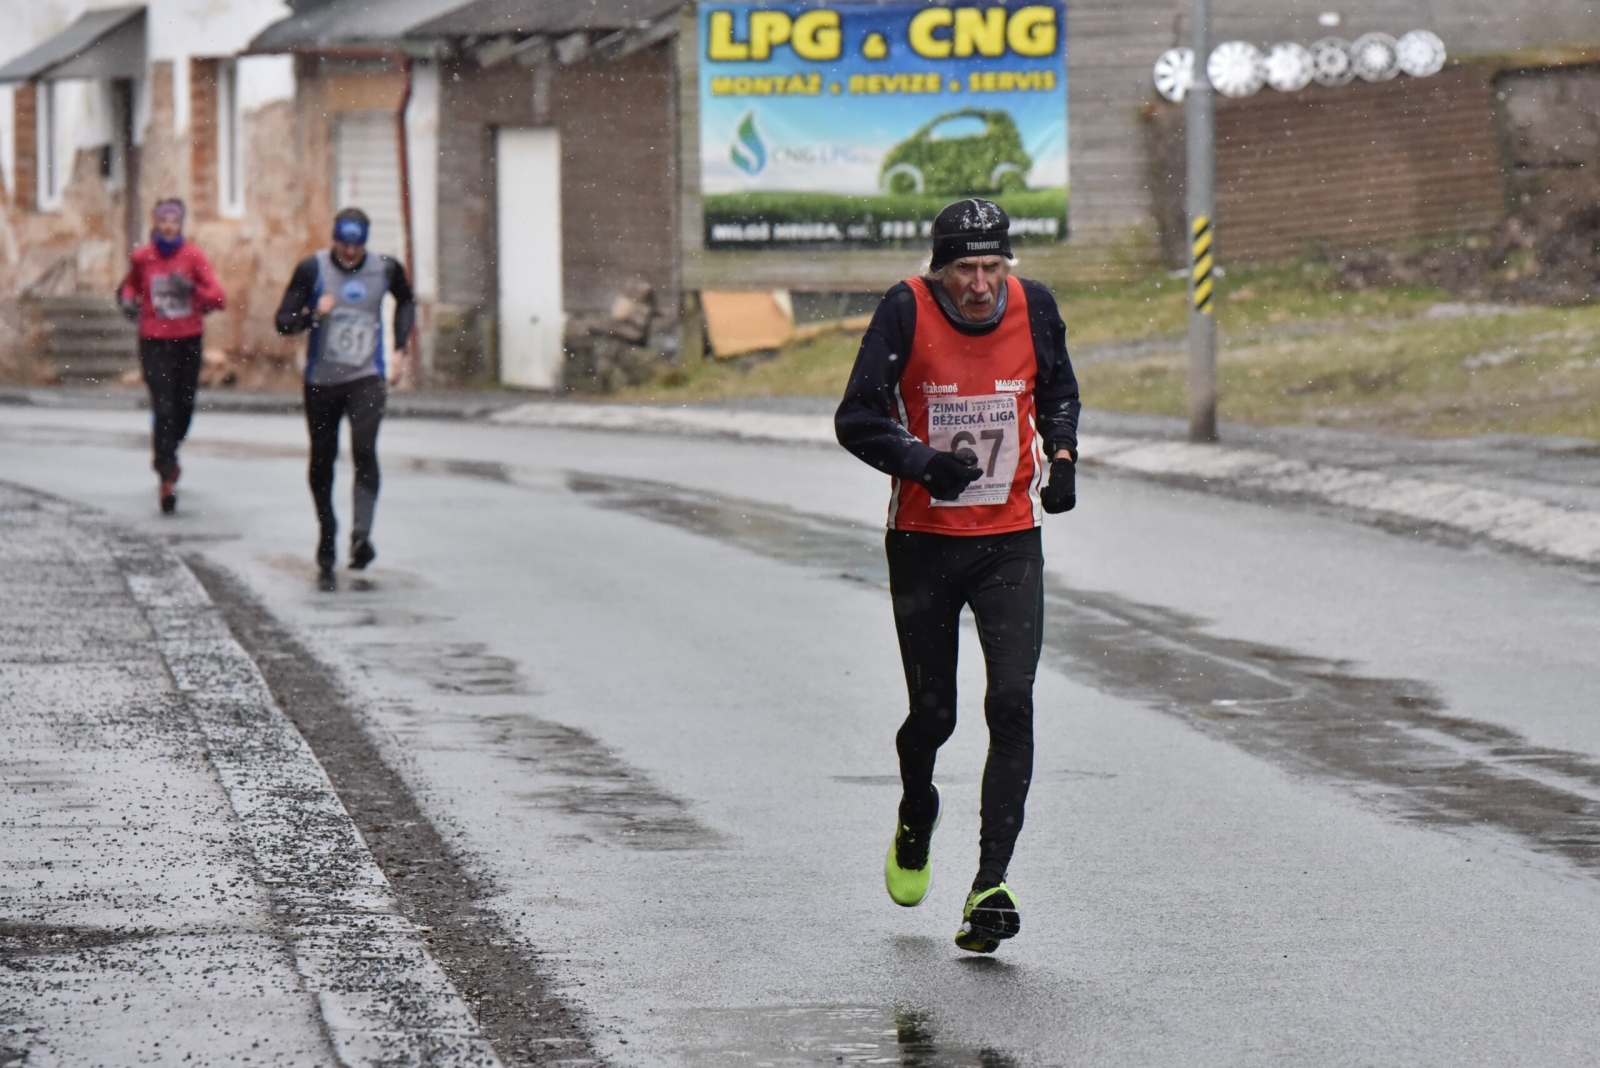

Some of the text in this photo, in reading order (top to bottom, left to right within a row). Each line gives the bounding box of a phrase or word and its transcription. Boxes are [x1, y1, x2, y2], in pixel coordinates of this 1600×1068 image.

[708, 10, 842, 61] LPG
[909, 6, 1057, 58] CNG
[711, 71, 1056, 95] MONTÁŽ REVIZE SERVIS
[966, 240, 1000, 251] TERMOVEL
[933, 400, 968, 413] ZIMNÍ
[932, 411, 1015, 426] BĚŽECKÁ LIGA
[951, 429, 1004, 478] 67
